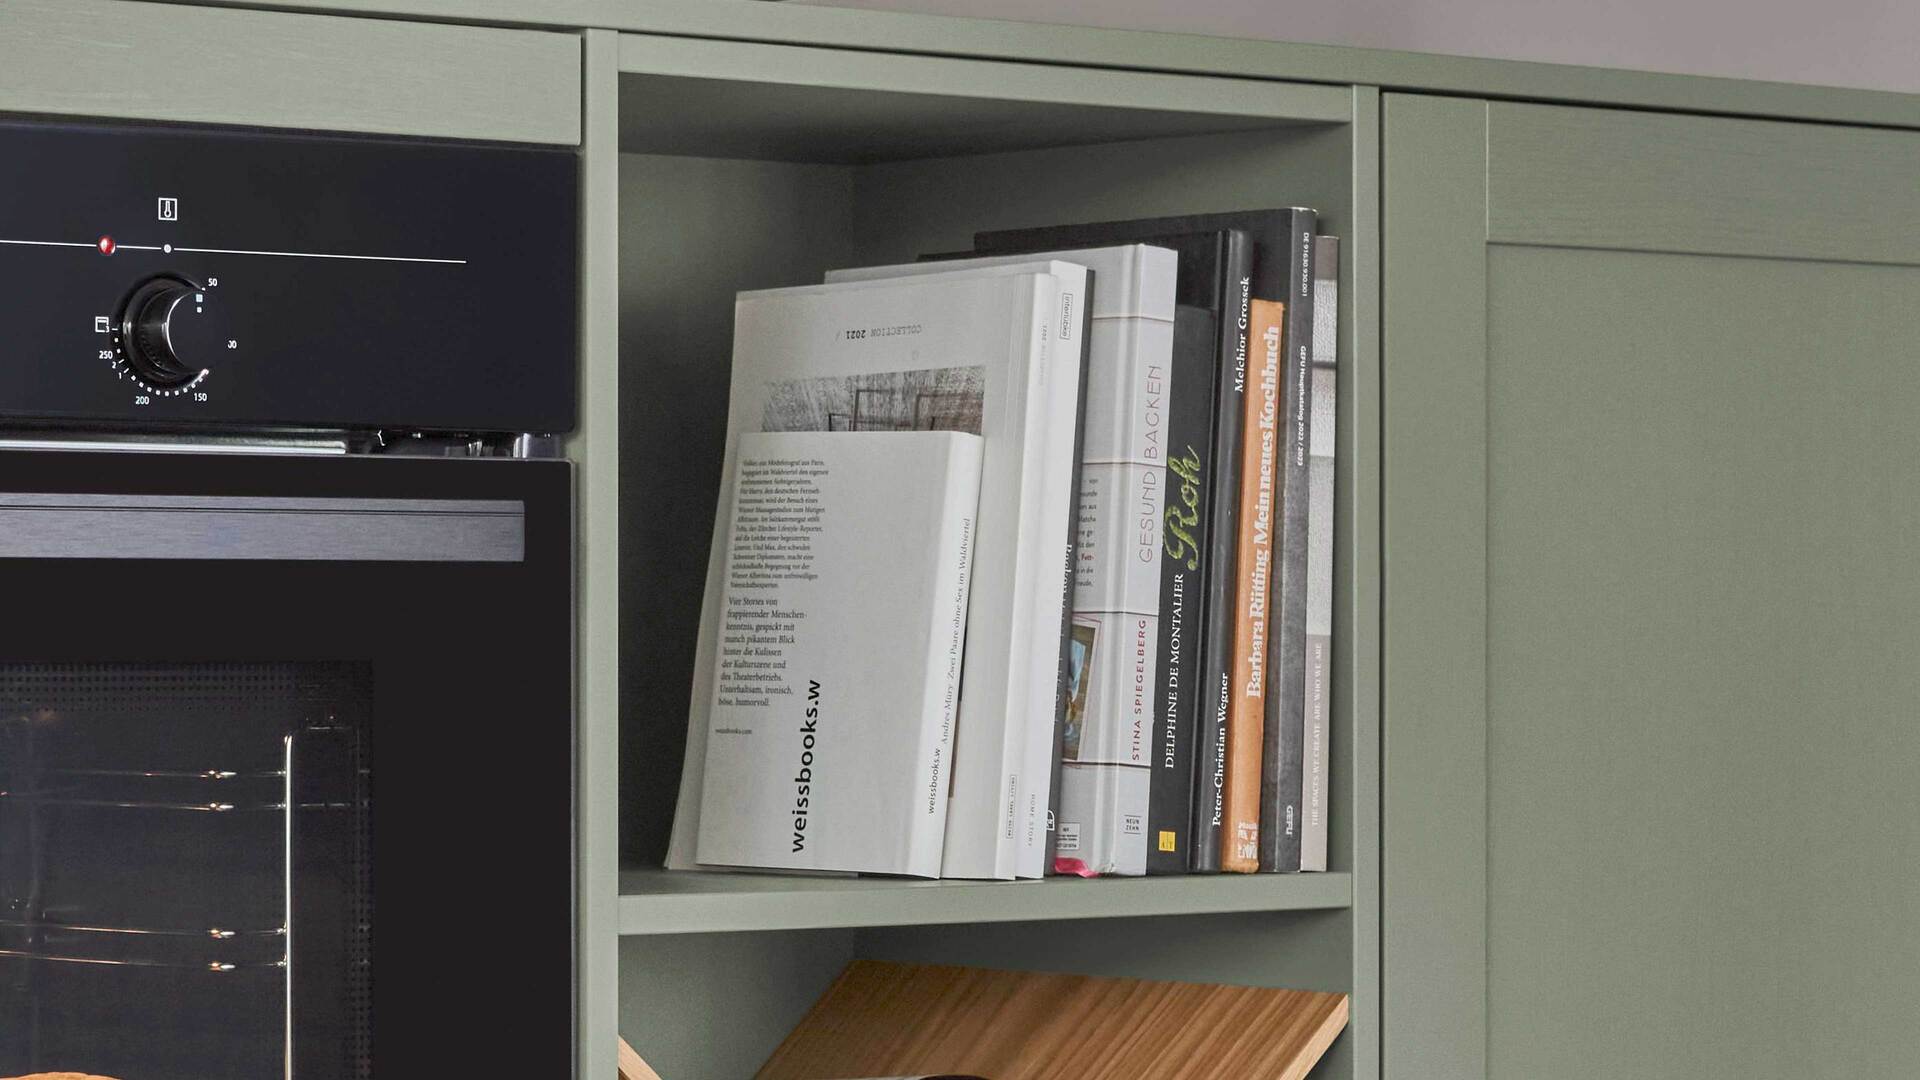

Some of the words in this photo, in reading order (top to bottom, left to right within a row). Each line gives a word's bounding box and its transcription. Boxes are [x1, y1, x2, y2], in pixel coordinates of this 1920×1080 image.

[1303, 232, 1310, 243] DE
[208, 278, 218, 288] 50
[1239, 276, 1250, 330] Grossek
[846, 329, 866, 340] 2021
[870, 324, 922, 337] COLLECTION
[99, 351, 113, 360] 250
[1234, 333, 1248, 394] Melchior
[118, 372, 122, 380] 1
[1260, 326, 1280, 429] Kochbuch
[135, 396, 150, 405] 200
[194, 393, 208, 402] 150
[1144, 365, 1162, 460] BACKEN
[1259, 432, 1274, 490] neues
[1139, 471, 1156, 563] GESUND
[1162, 445, 1201, 571] Roh
[1253, 491, 1270, 545] Mein
[959, 517, 971, 570] Waldviertel
[743, 596, 765, 606] Stories
[765, 596, 778, 606] von
[955, 587, 964, 603] Sex
[1249, 547, 1270, 619] Rütting
[952, 605, 962, 629] ohne
[1170, 573, 1184, 665] MONTALIER
[754, 646, 782, 656] Kulissen
[779, 634, 795, 644] Blick
[949, 631, 960, 655] Paare
[773, 658, 786, 669] und
[946, 657, 957, 679] Zwei
[1135, 618, 1147, 714] SPIEGELBERG
[1246, 621, 1265, 698] Barbara
[1168, 668, 1180, 689] DE
[1217, 672, 1229, 723] Wegner
[941, 712, 952, 745] Andres
[1132, 720, 1142, 761] STINA
[1164, 691, 1178, 769] DELPHINE
[791, 679, 822, 854] weissbooks.w
[927, 748, 942, 815] weissbooks.w
[1211, 727, 1227, 827] Peter-Christian
[1285, 804, 1294, 835] GEFU
